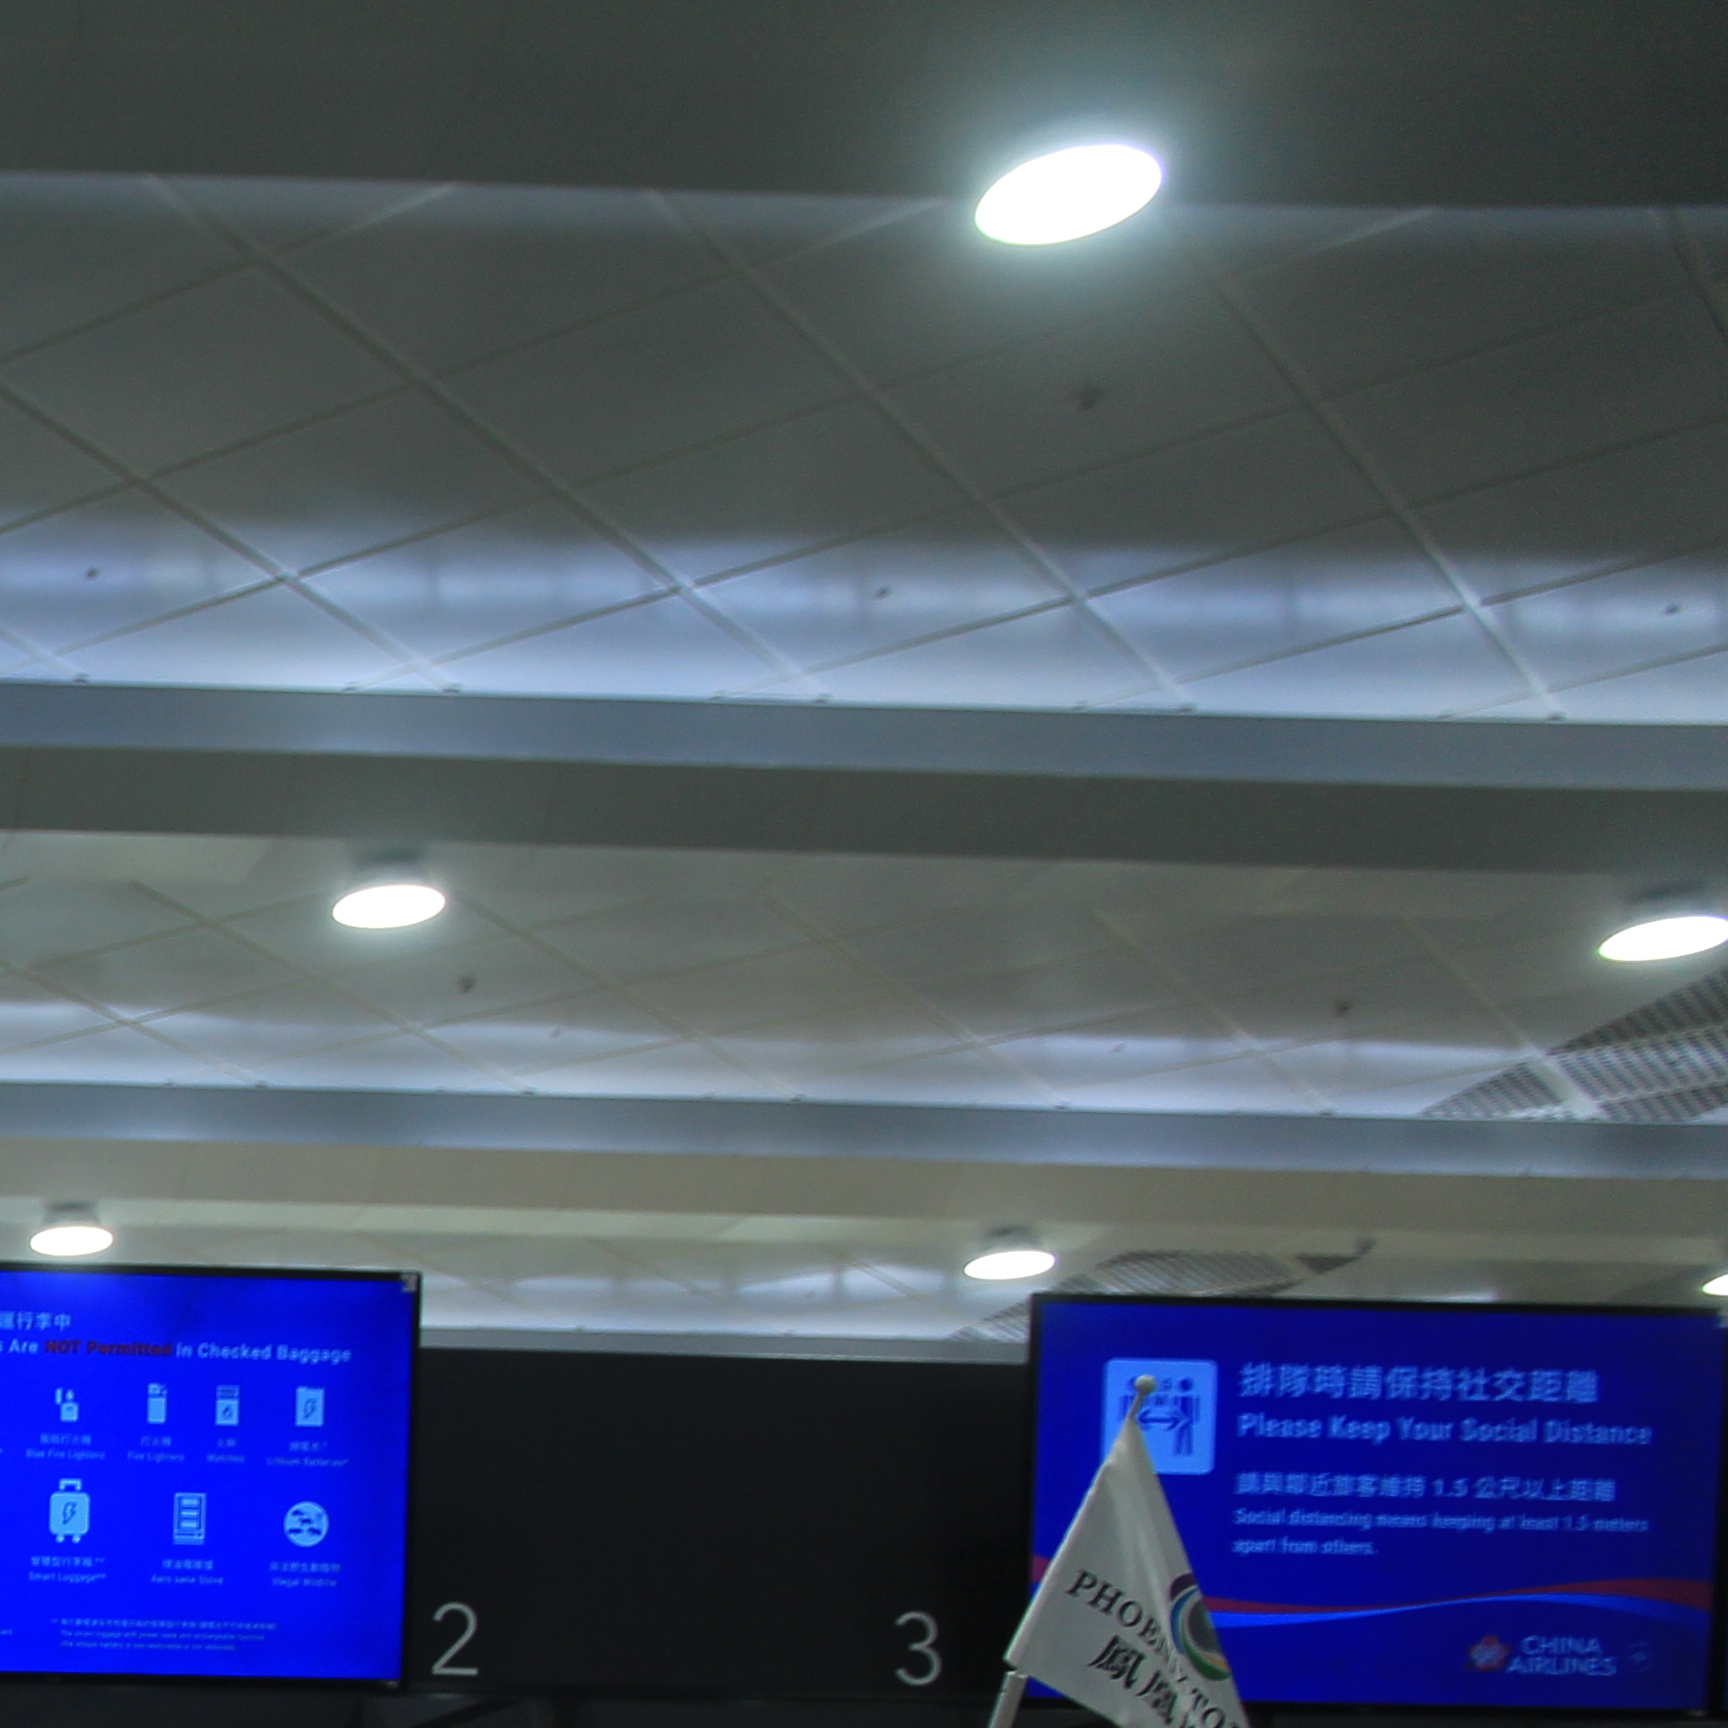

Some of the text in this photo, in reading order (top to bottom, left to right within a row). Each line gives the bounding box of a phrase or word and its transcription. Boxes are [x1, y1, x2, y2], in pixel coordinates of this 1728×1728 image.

[9, 1338, 39, 1355] Are
[45, 1339, 82, 1356] NOT
[87, 1340, 173, 1358] Permitted
[197, 1344, 272, 1362] Checked
[277, 1345, 351, 1365] Baggage
[1237, 1361, 1600, 1404] 排隊時請保持社交距離
[1236, 1411, 1653, 1446] Please Keep Your Social Distance
[1431, 1477, 1470, 1498] 1.5
[1232, 1507, 1650, 1533] Social distancing means keeping at least 1.5 meters
[1231, 1538, 1277, 1557] apart
[1280, 1536, 1318, 1555] from
[431, 1602, 479, 1676] 2
[894, 1610, 943, 1686] 3
[1521, 1636, 1602, 1656] CHINA
[1506, 1655, 1618, 1677] AIRLINES
